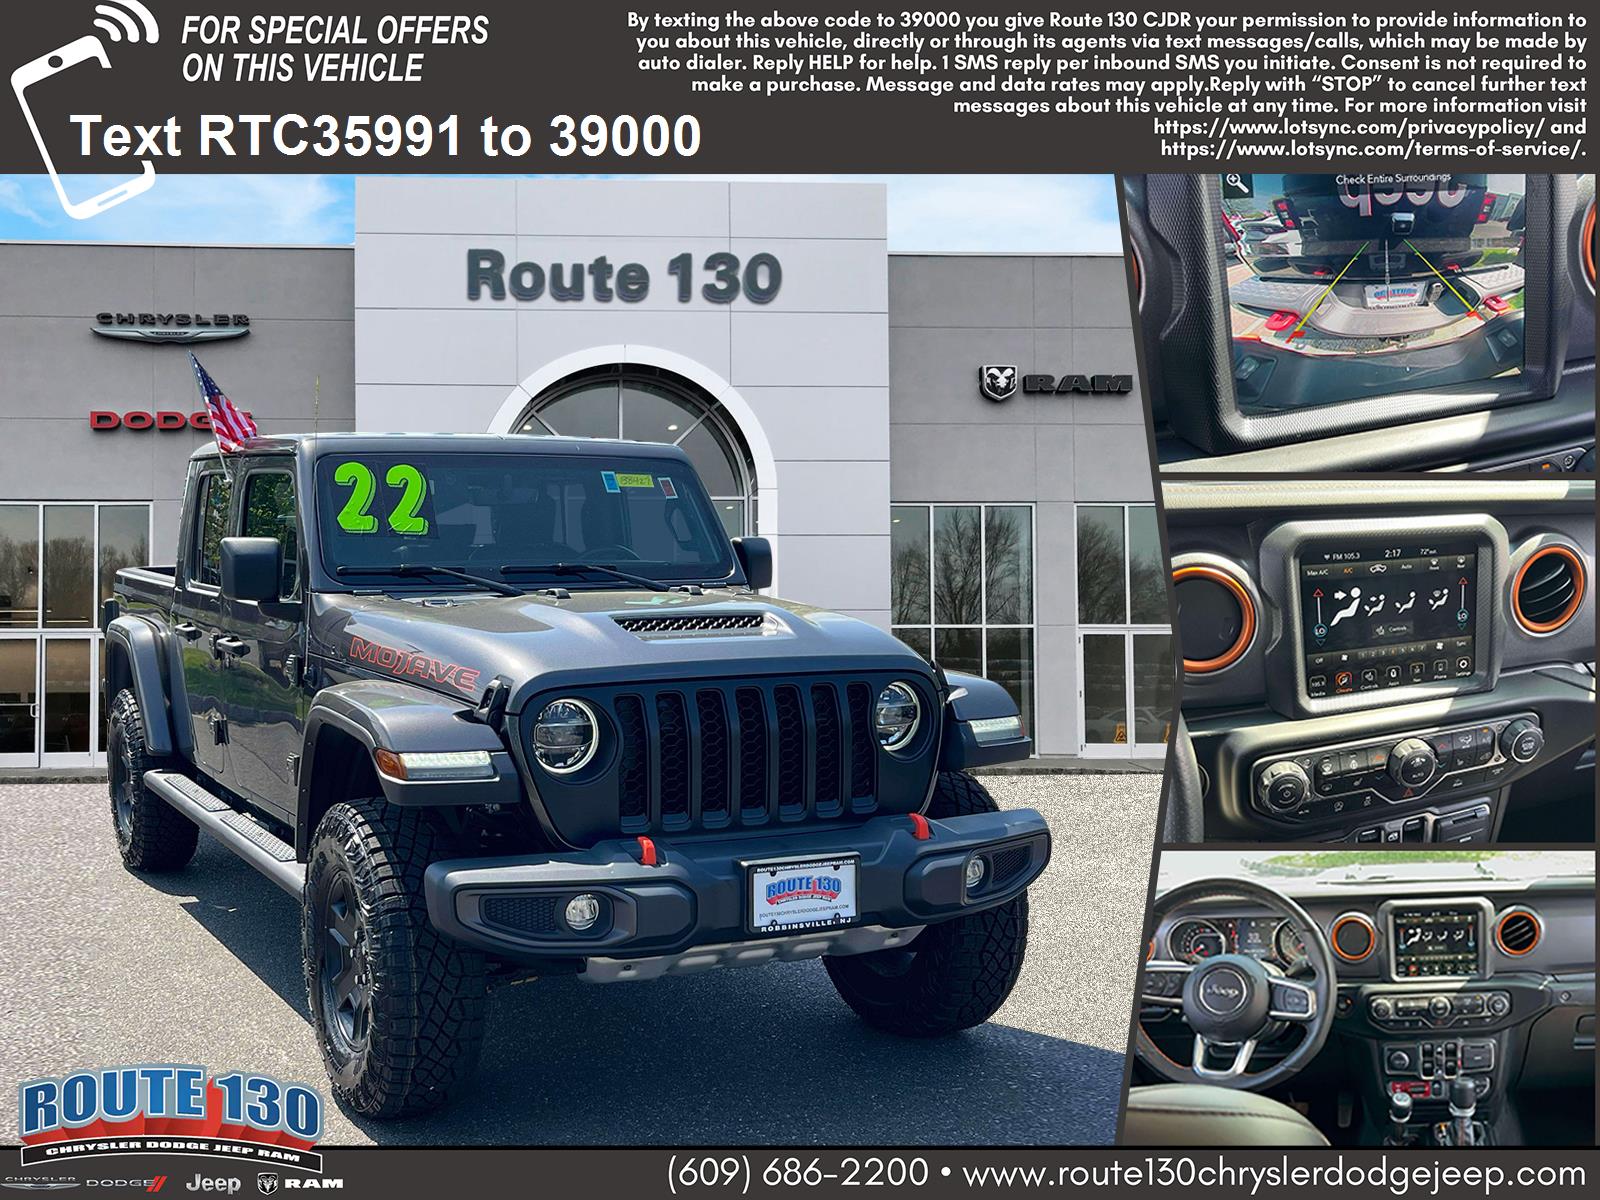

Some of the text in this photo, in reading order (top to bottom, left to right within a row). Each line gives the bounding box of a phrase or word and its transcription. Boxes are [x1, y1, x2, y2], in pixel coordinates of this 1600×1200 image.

[1336, 173, 1452, 185] Check Entire Surroundings
[466, 248, 783, 305] Route 130
[95, 312, 250, 326] CHRYSLER
[1022, 374, 1133, 394] RAM
[89, 410, 252, 430] DODG
[334, 461, 430, 536] 22
[1384, 548, 1401, 558] 2:17
[349, 636, 481, 692] MOJAVE
[766, 875, 841, 899] ROUTE 130
